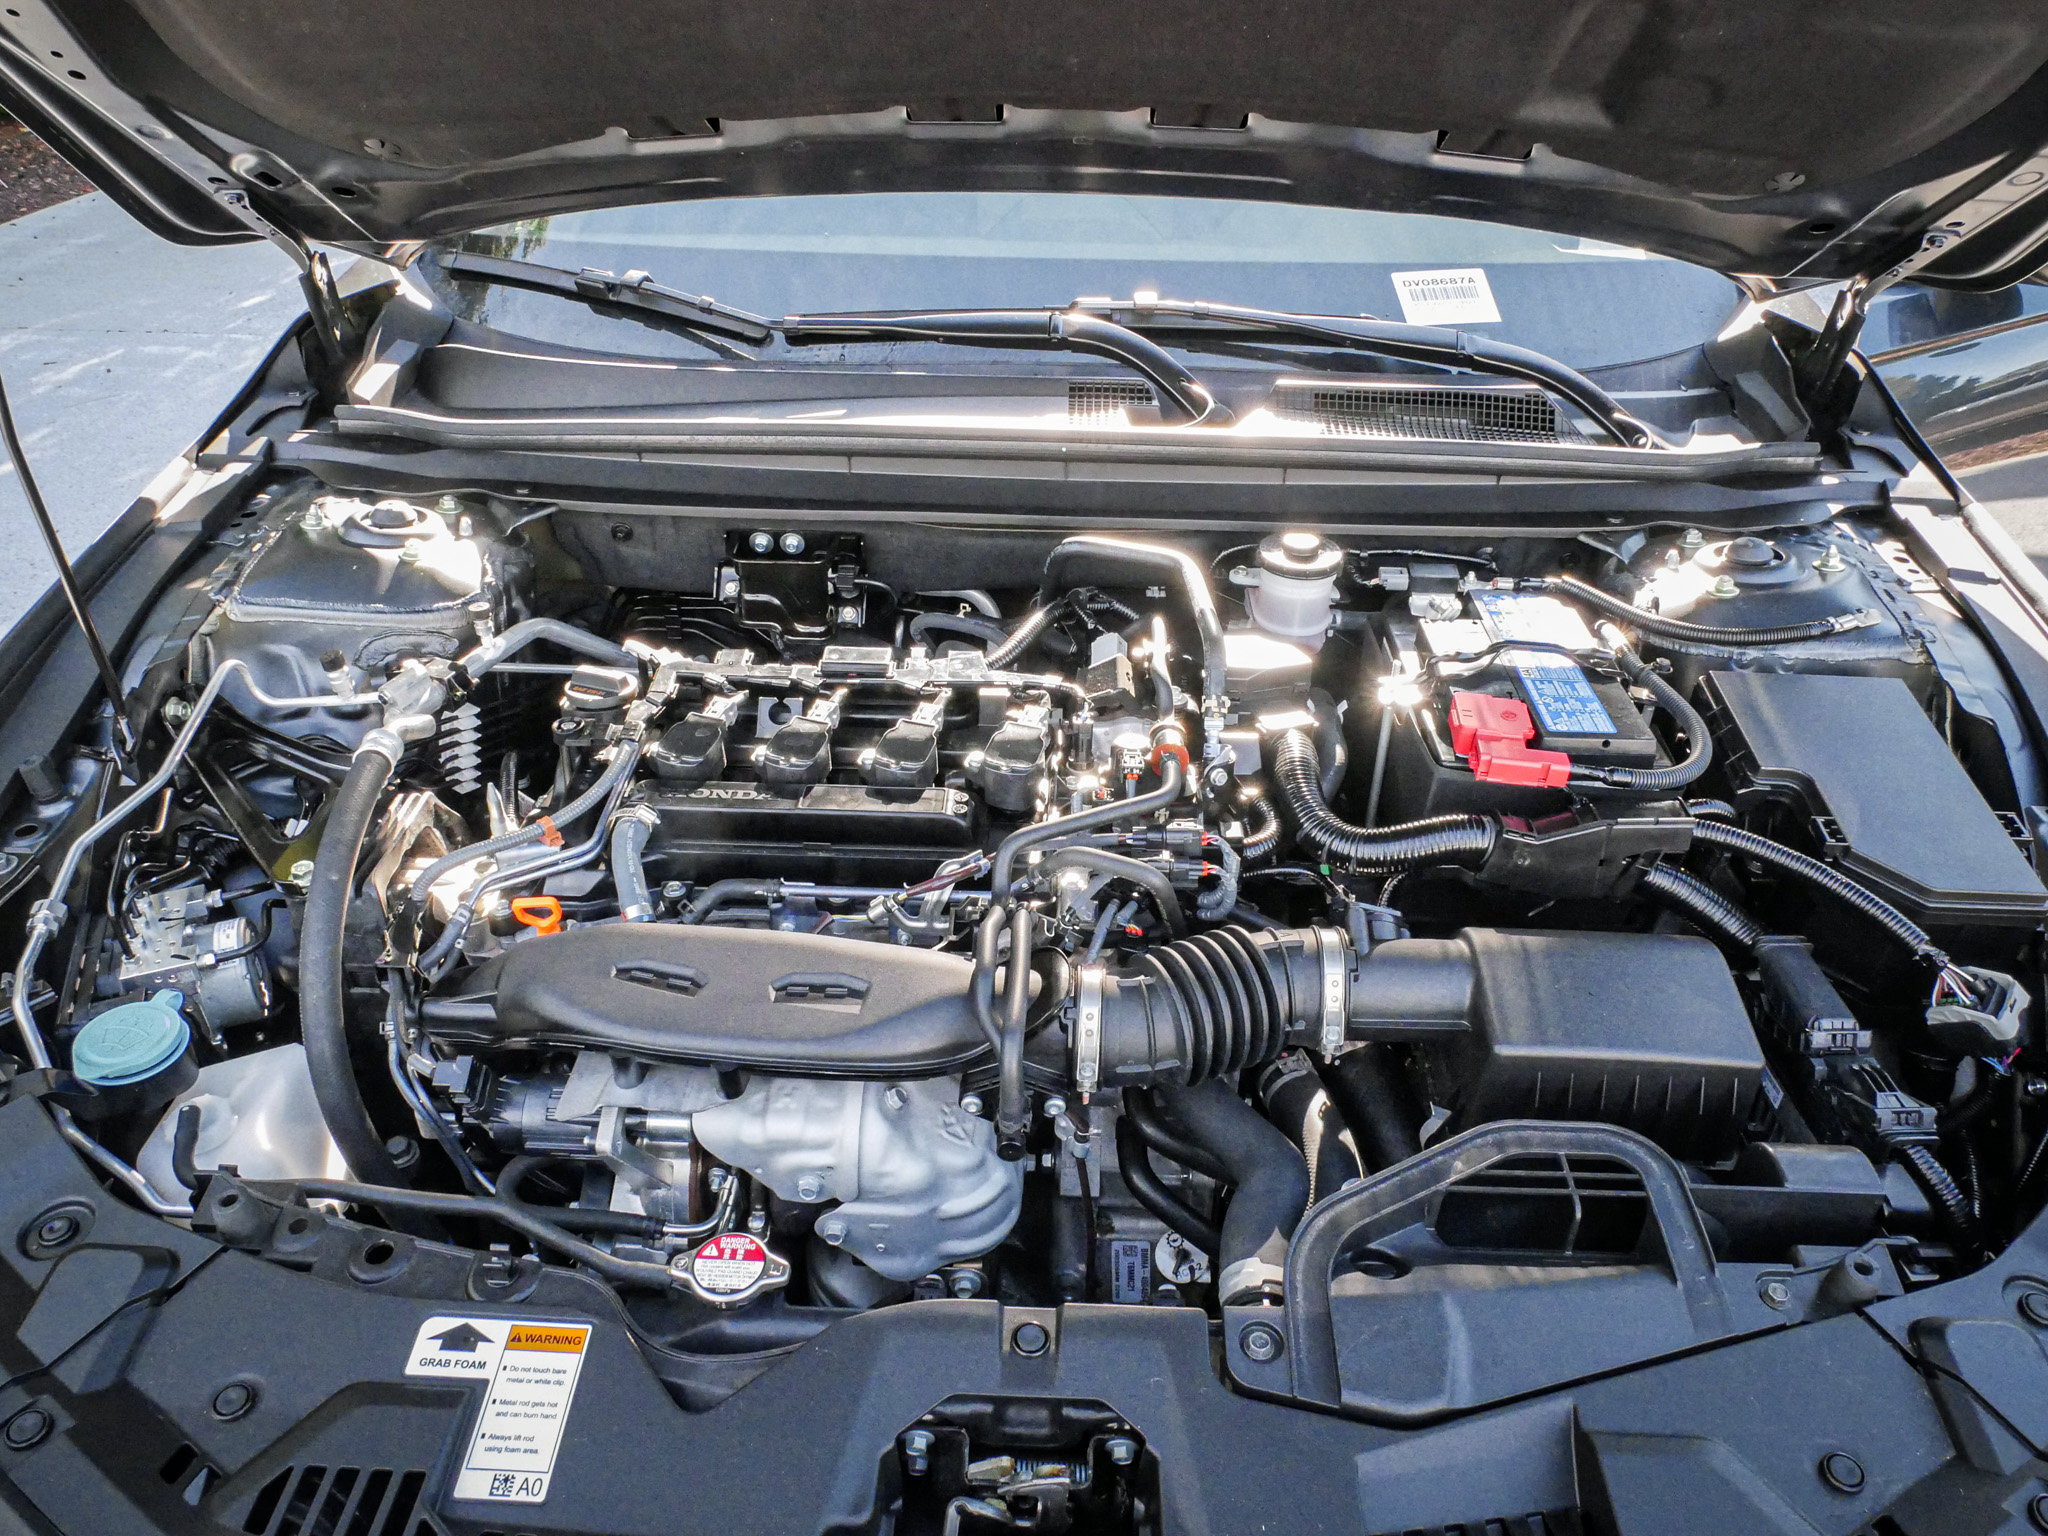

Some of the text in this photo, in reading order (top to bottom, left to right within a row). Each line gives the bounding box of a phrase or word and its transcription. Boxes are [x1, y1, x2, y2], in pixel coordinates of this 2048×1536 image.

[1402, 277, 1476, 287] DV08687A
[525, 1333, 582, 1346] WARNING
[419, 1358, 487, 1370] GRAB FOAM
[552, 1367, 567, 1375] bare
[488, 1433, 512, 1441] Always
[484, 1446, 503, 1454] using
[516, 1477, 543, 1497] A0
